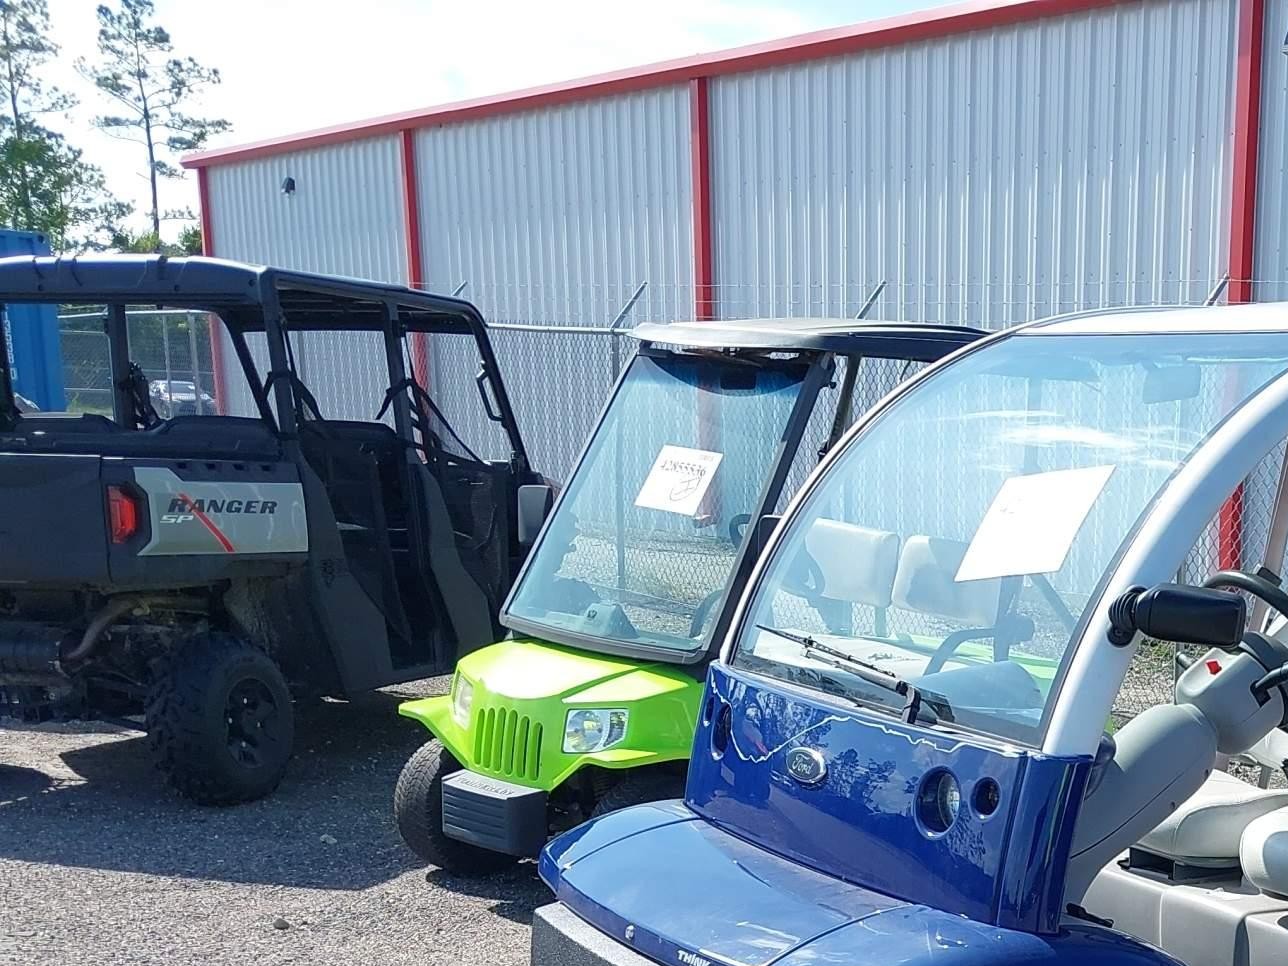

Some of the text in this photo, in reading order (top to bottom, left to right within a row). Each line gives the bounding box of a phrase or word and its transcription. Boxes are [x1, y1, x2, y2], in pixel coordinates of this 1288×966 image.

[167, 498, 278, 514] RANGER
[159, 515, 194, 524] SP
[792, 753, 814, 775] Ford
